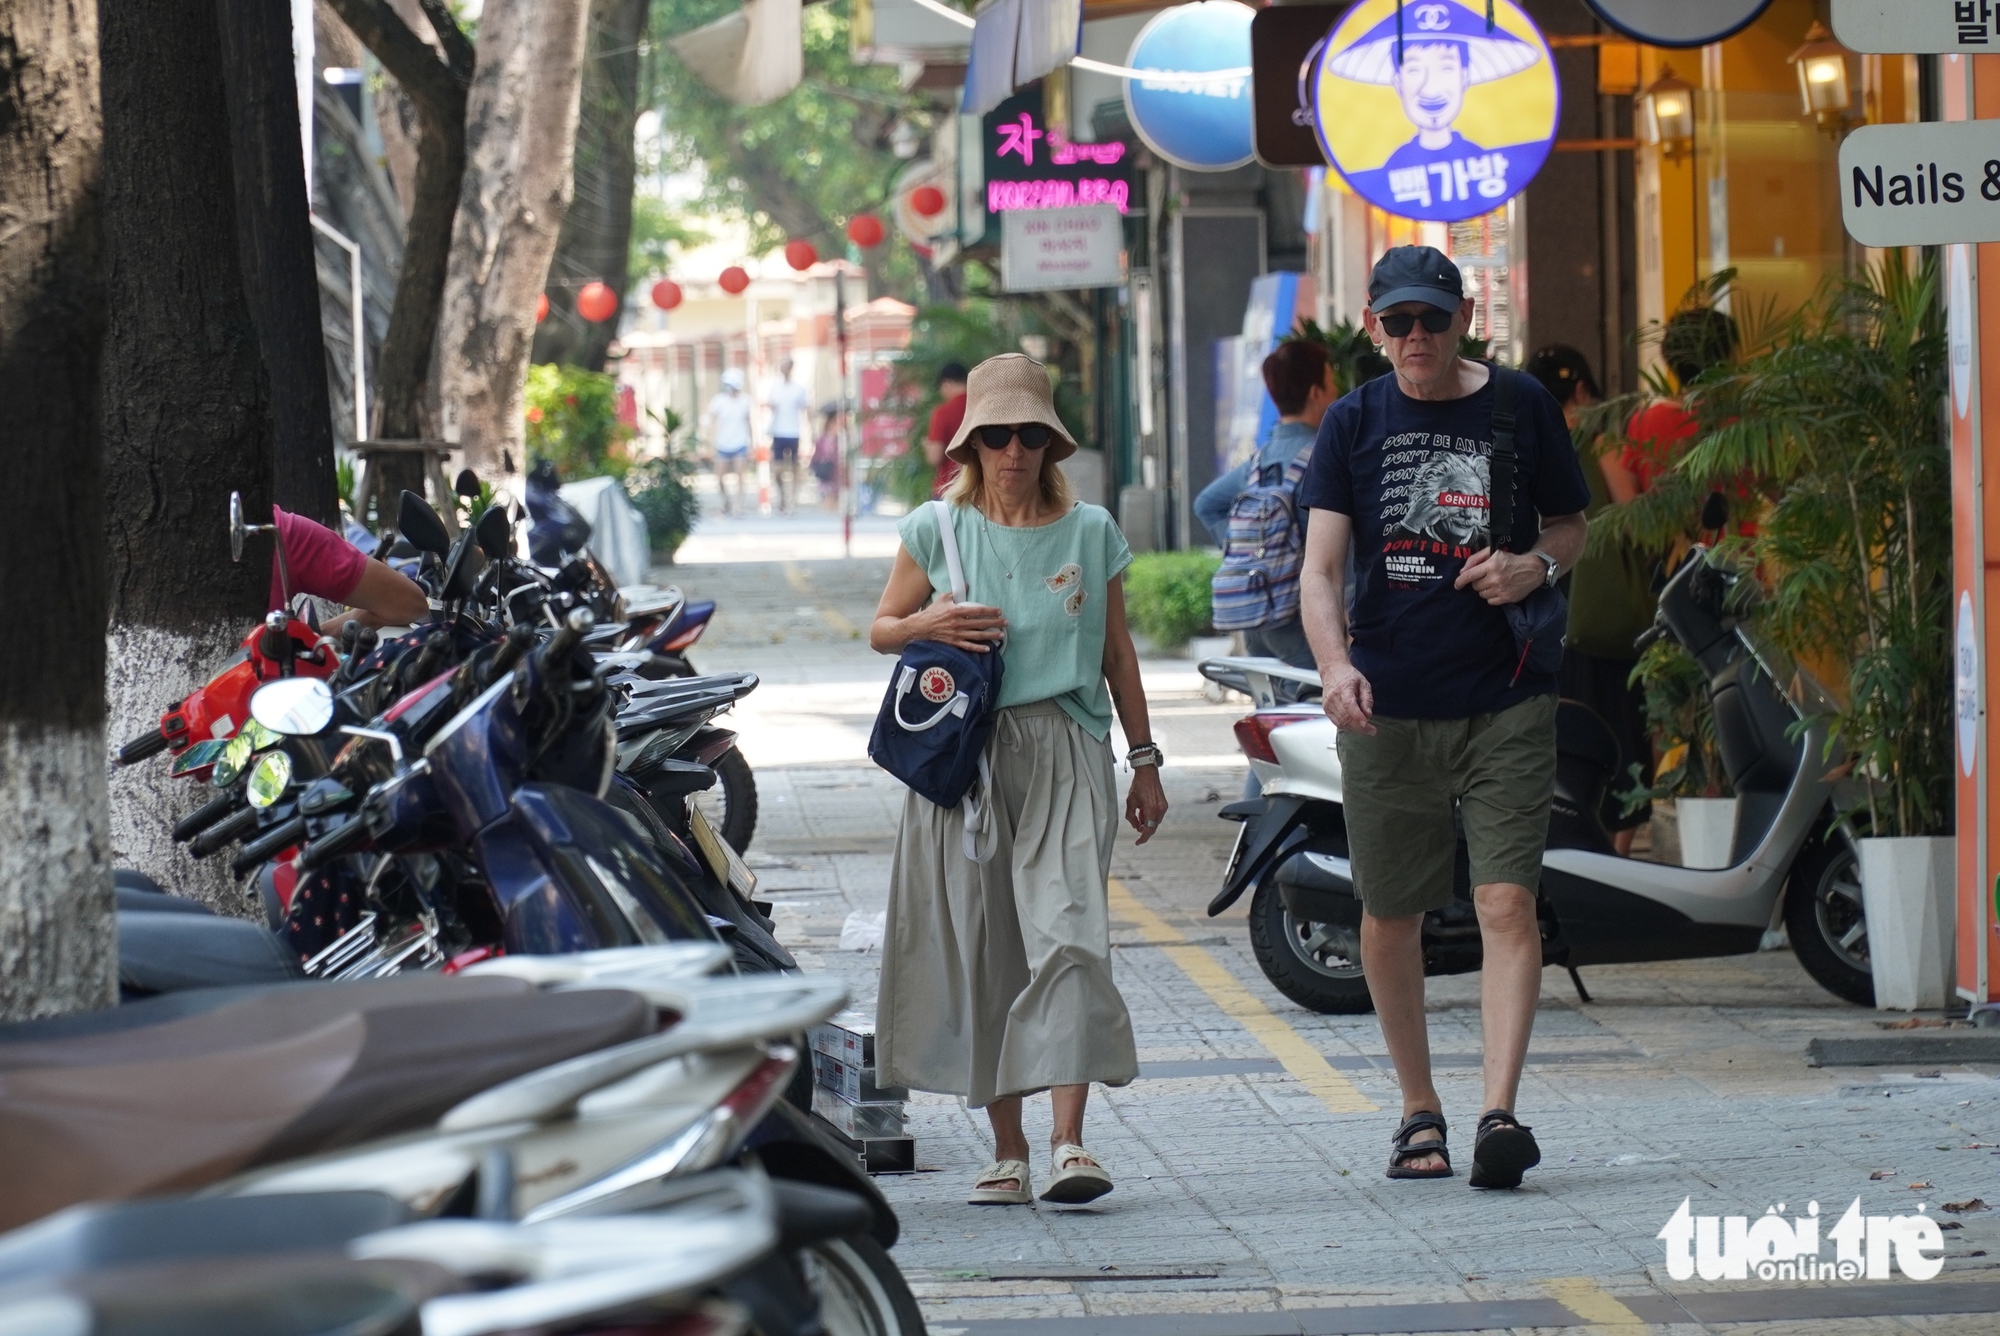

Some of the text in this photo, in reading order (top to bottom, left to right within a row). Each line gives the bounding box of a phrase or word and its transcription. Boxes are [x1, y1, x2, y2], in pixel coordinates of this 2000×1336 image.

[1955, 0, 2000, 44] 발
[1853, 162, 1965, 207] Nails
[1382, 432, 1430, 450] DON'T
[1433, 434, 1450, 448] BE
[1455, 437, 1476, 454] AN
[1382, 450, 1430, 467] DON'T
[1445, 493, 1485, 507] GENIUS
[1382, 539, 1472, 560] DON'T BE AN
[1385, 555, 1426, 566] ALBERT
[1386, 563, 1435, 574] EINSTEIN
